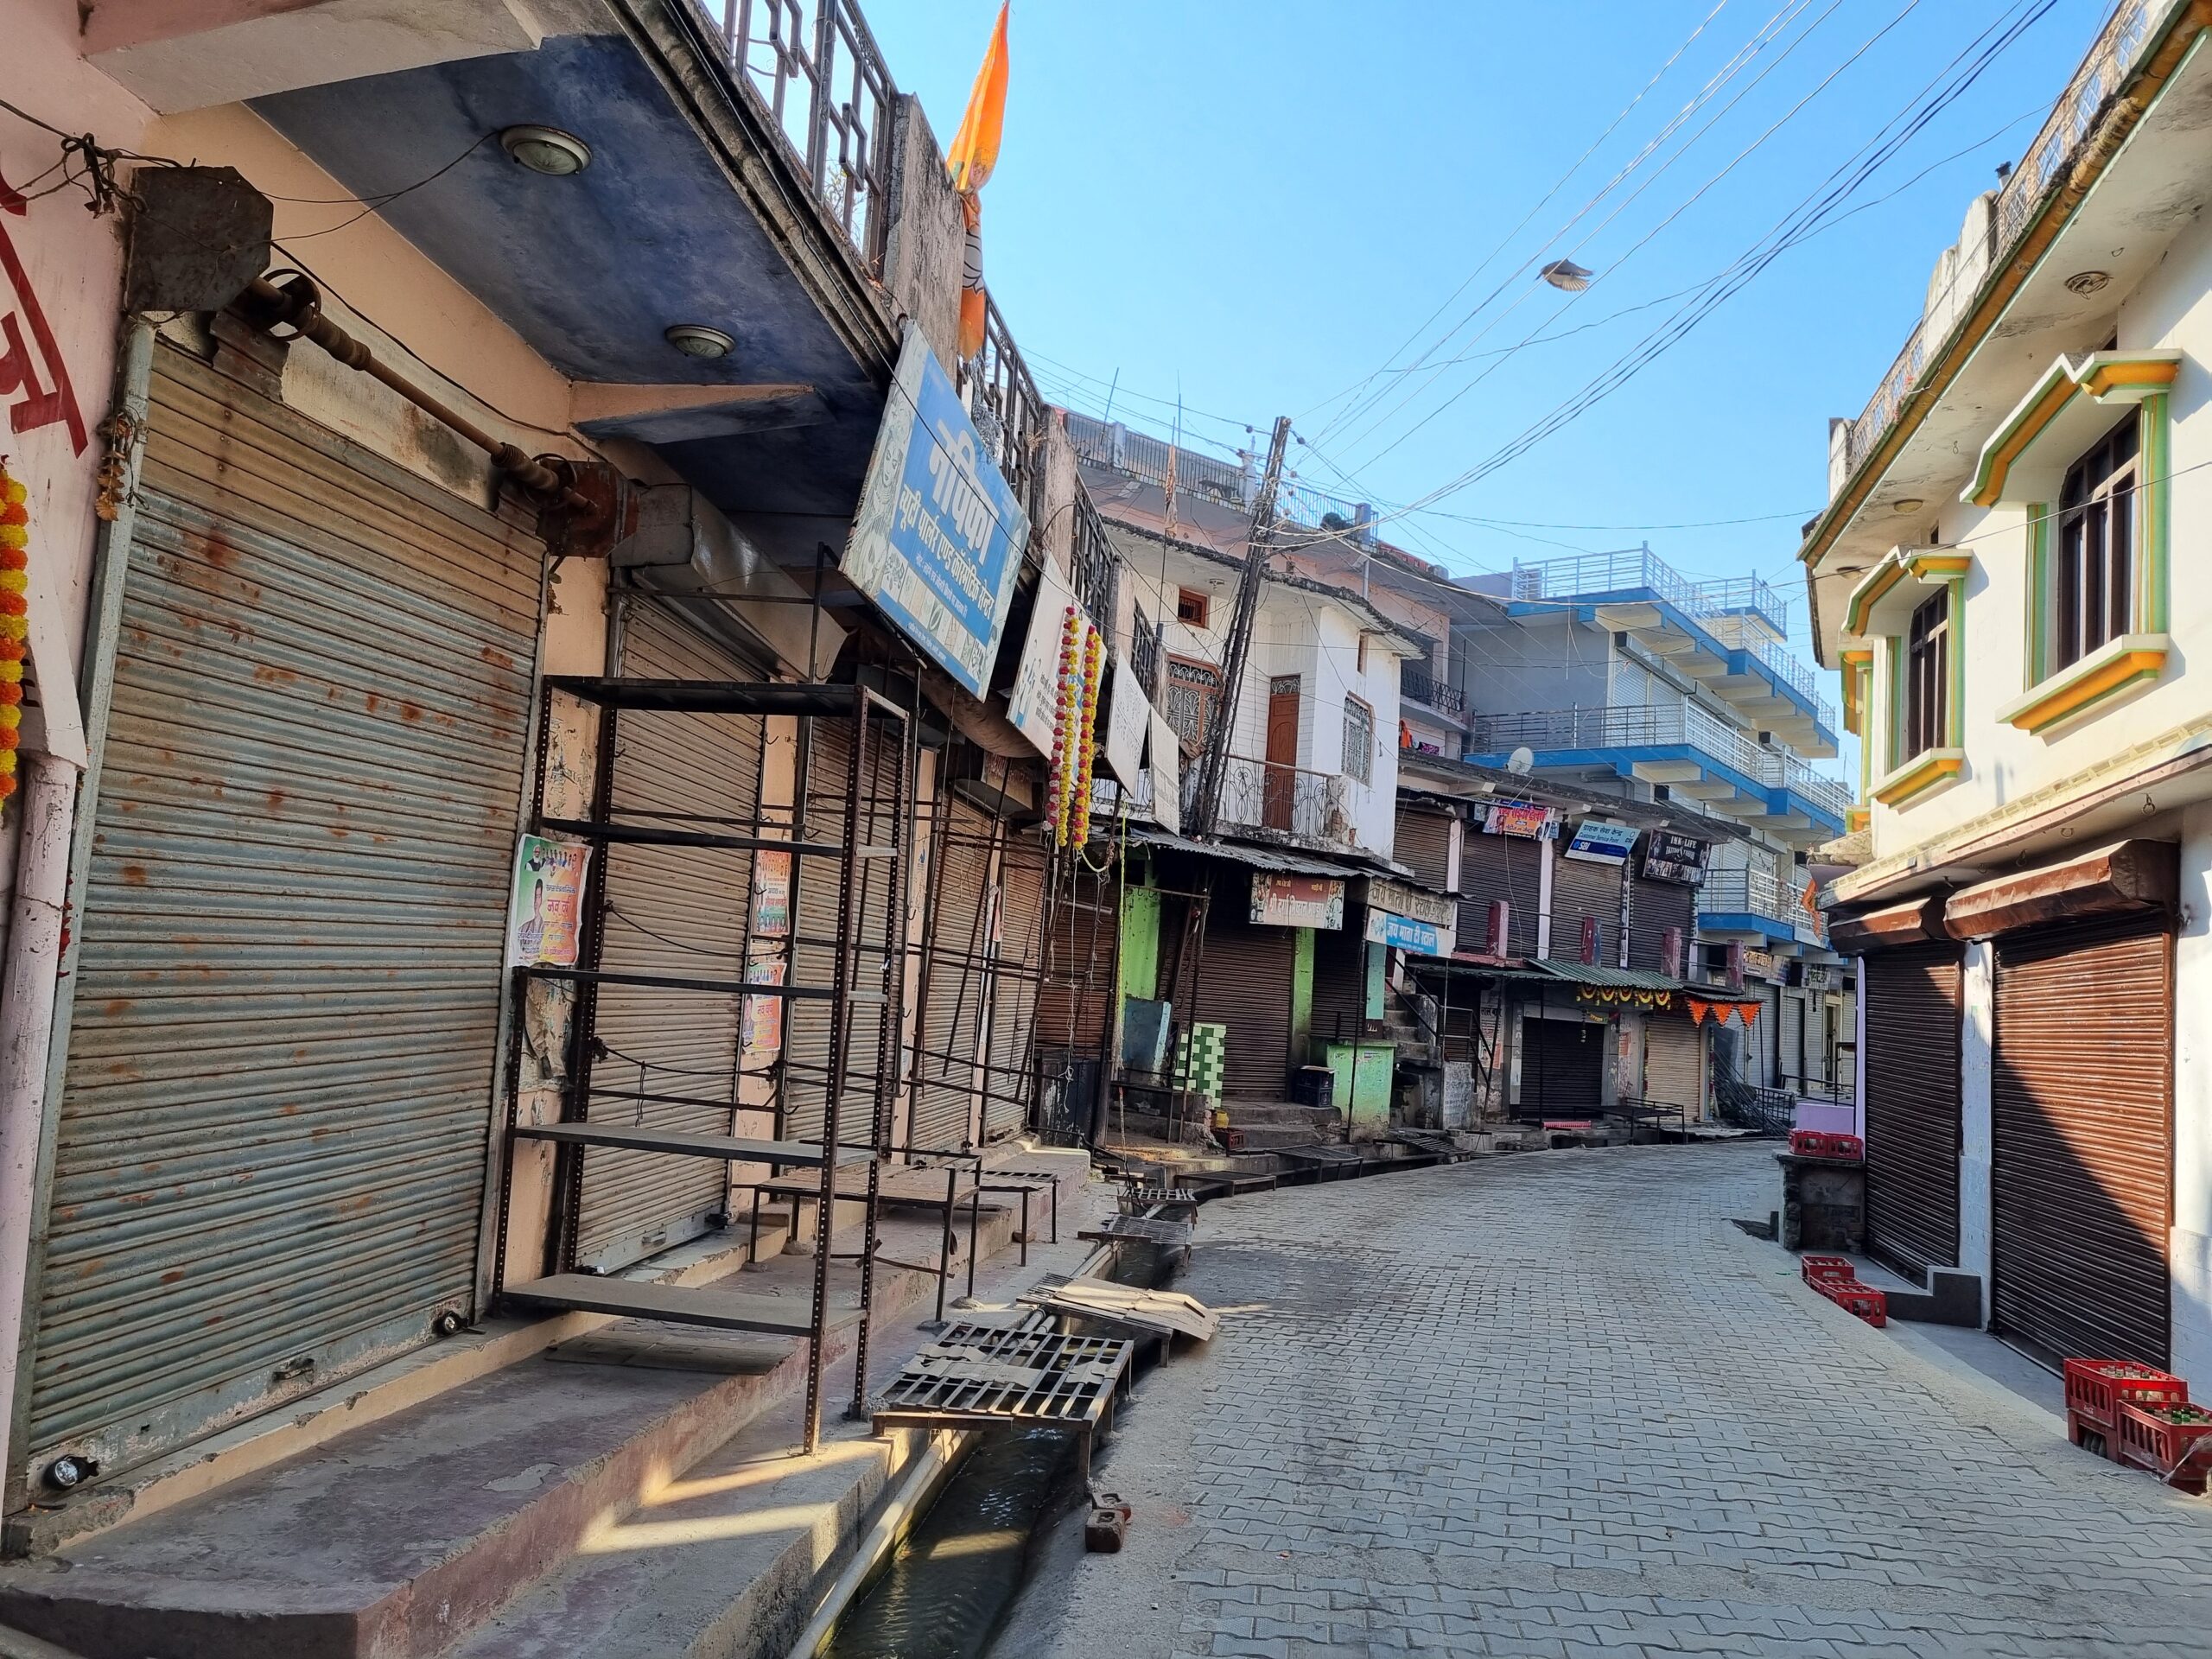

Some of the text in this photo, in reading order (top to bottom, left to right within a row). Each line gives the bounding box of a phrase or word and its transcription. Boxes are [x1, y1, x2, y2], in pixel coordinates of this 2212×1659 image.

[899, 484, 921, 531] ब्यूटी
[918, 509, 940, 552] पार्लर
[938, 533, 955, 569] एण्ड
[1611, 827, 1624, 836] केन्द्र
[1579, 842, 1591, 851] SBI
[1670, 836, 1697, 849] INK LIFE
[1372, 883, 1386, 904] जय
[1388, 922, 1399, 939] जय
[1400, 925, 1413, 942] माता
[1421, 931, 1435, 947] स्टाल
